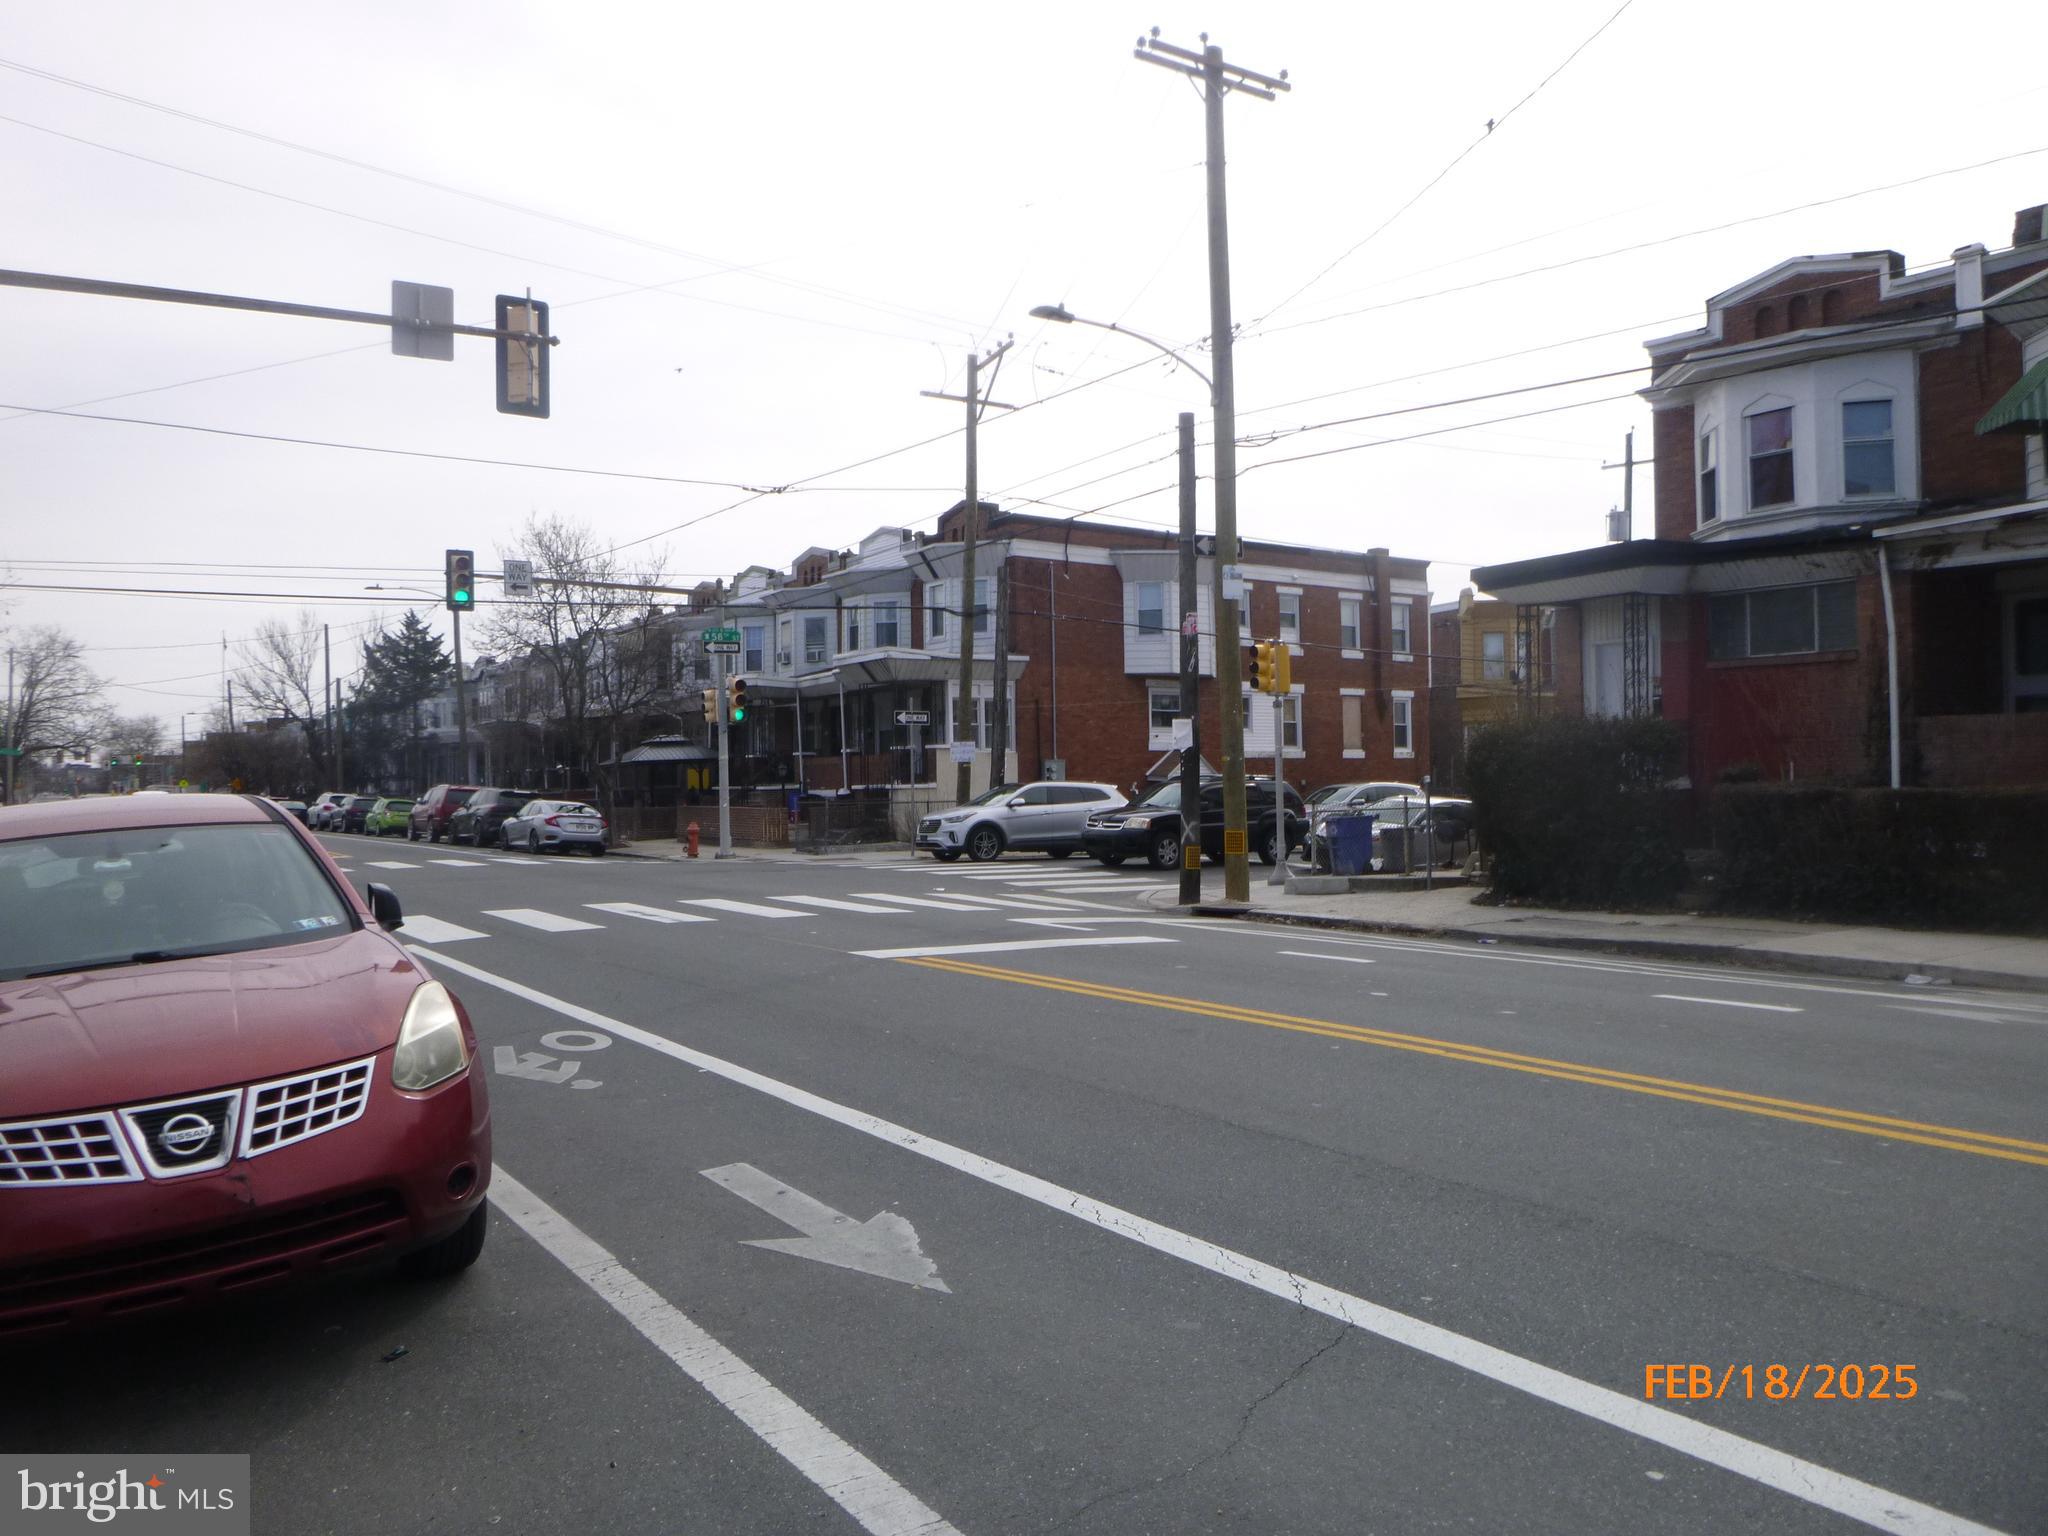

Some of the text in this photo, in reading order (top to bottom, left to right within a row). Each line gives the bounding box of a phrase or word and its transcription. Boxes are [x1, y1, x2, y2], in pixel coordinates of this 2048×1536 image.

[509, 563, 527, 572] ONE
[508, 573, 528, 582] WAY
[165, 1128, 209, 1142] NISSAN
